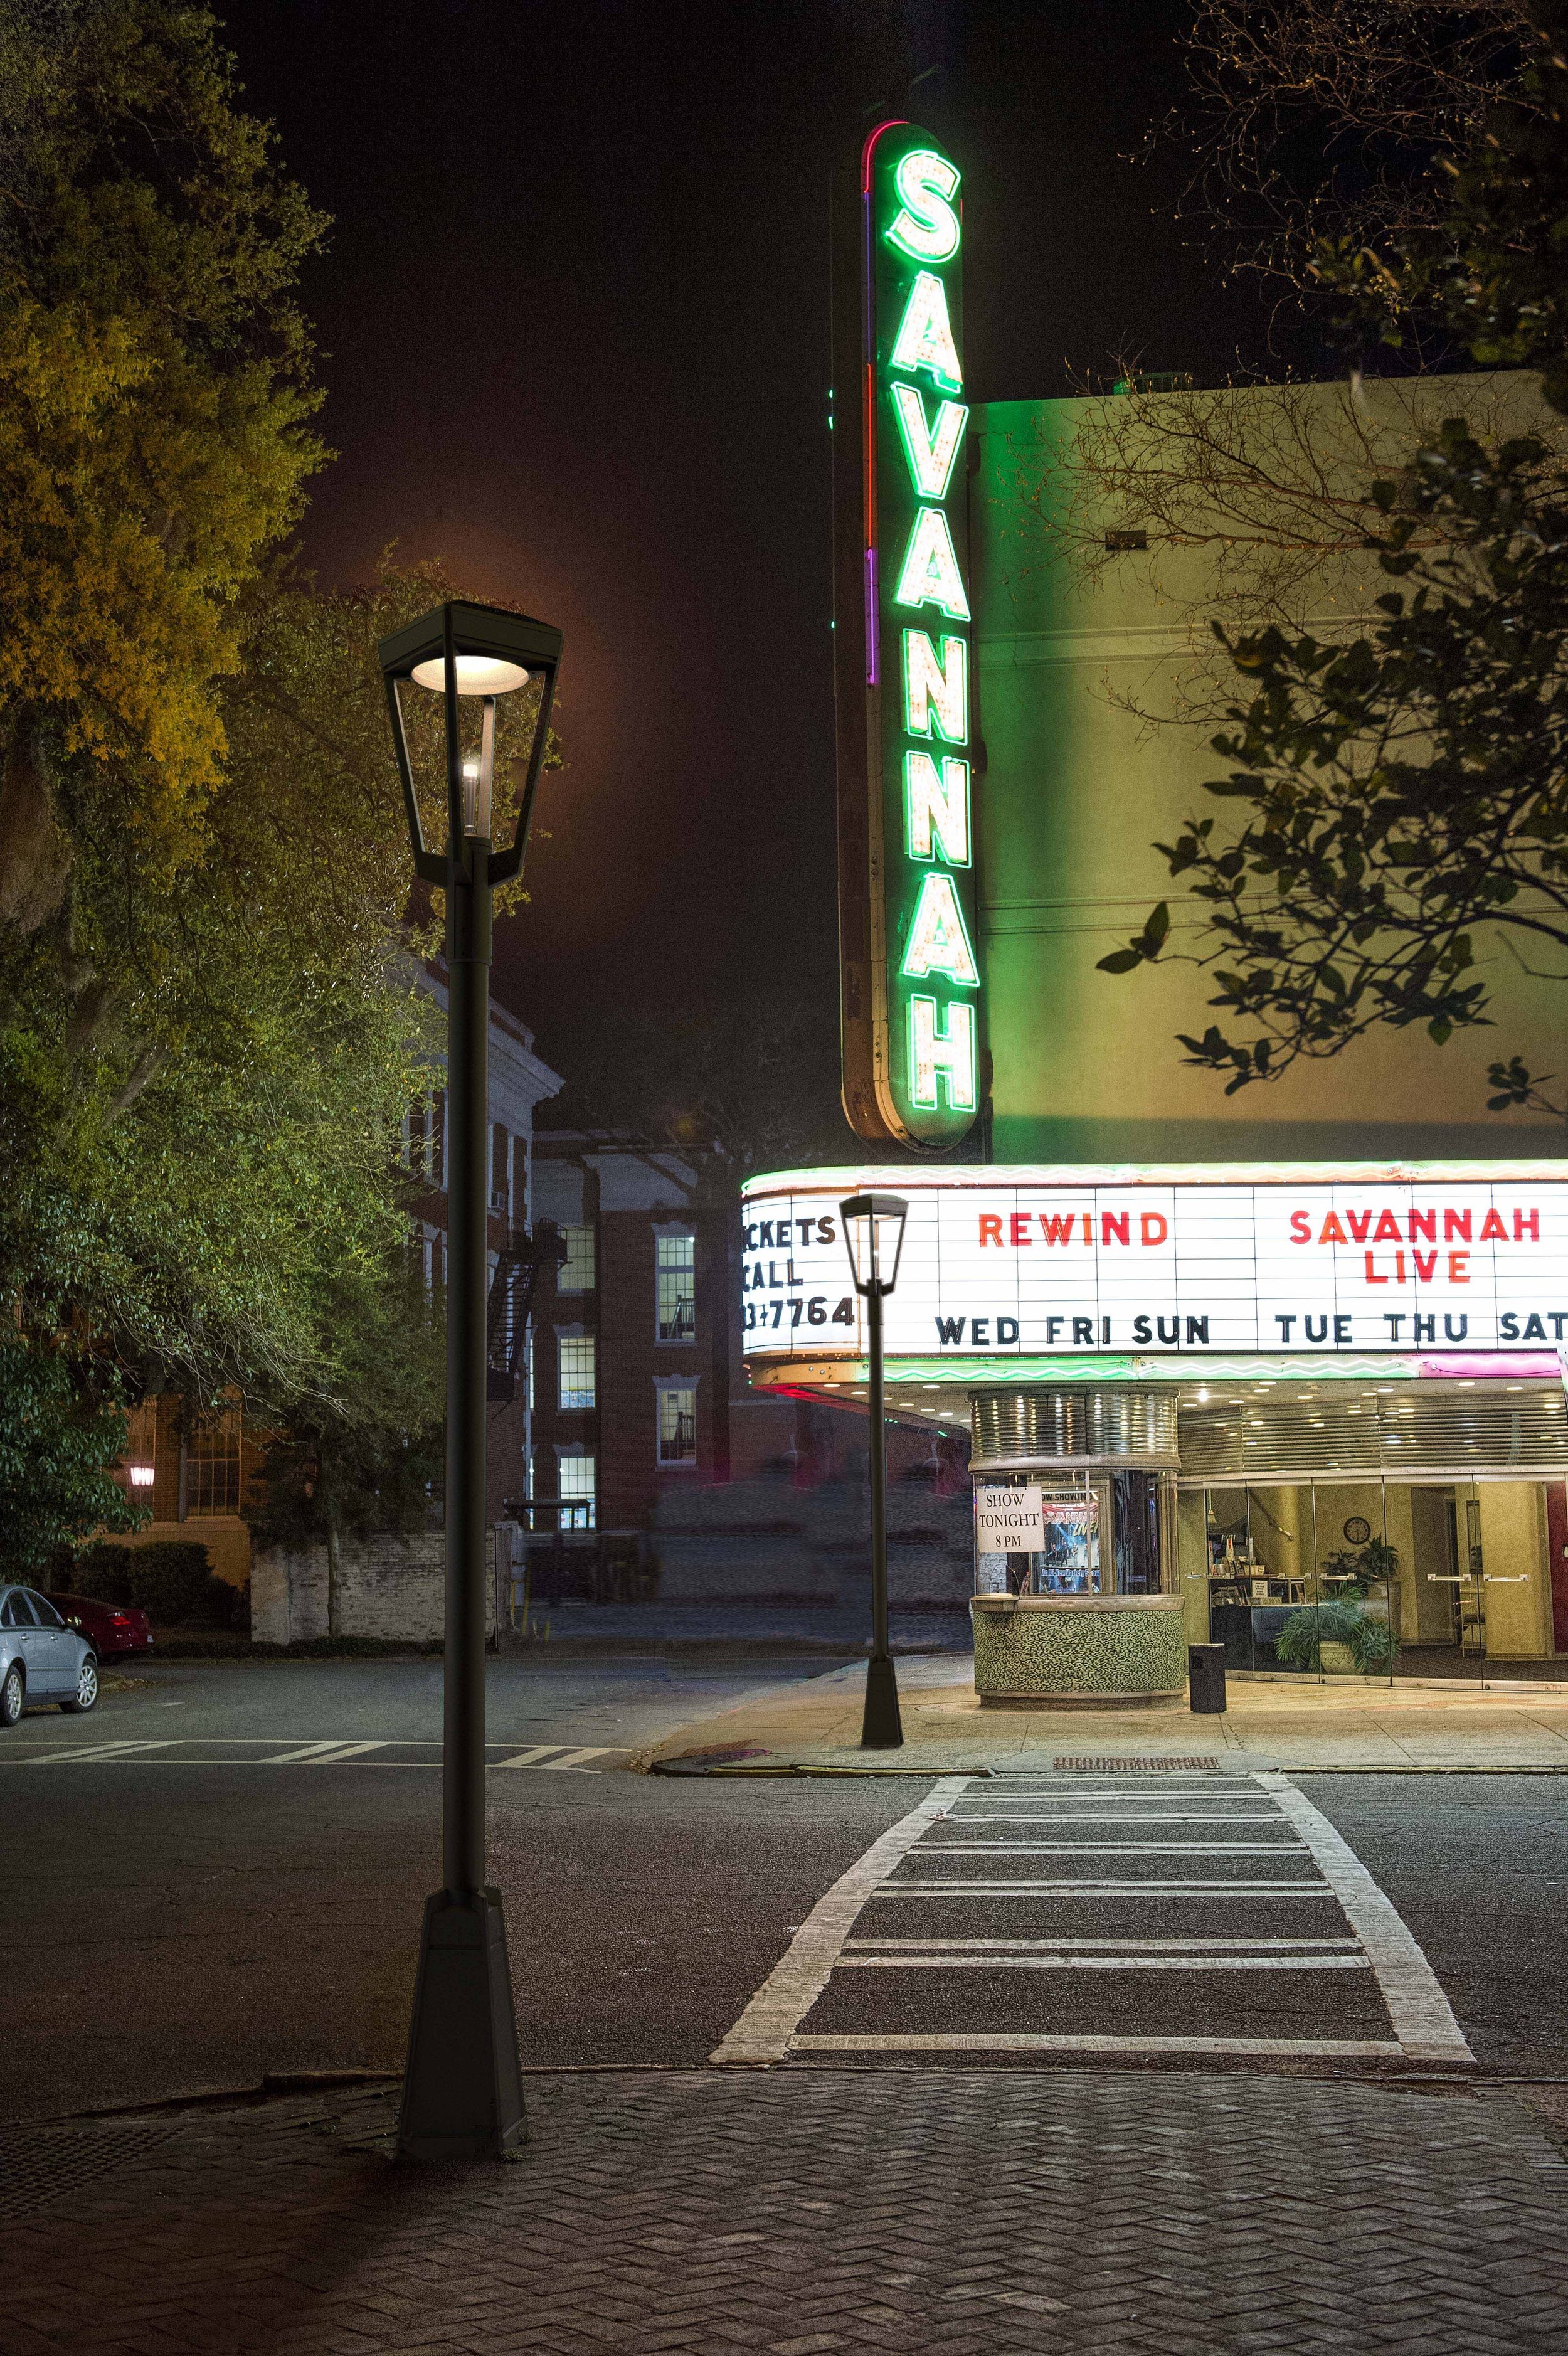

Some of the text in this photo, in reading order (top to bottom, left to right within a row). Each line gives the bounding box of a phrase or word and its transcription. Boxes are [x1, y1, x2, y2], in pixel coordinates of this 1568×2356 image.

[885, 149, 980, 1112] SAVANNAH
[742, 1216, 836, 1253] CKETS
[979, 1212, 1168, 1247] REWIND
[1290, 1208, 1540, 1244] SAVANNAH
[741, 1258, 804, 1293] CALL
[1365, 1249, 1471, 1285] LIVE
[935, 1315, 1209, 1346] WED FRI SUN
[1274, 1312, 1568, 1344] TUE THU SAT
[987, 1493, 1025, 1507] SHOW
[979, 1512, 1039, 1527] TONIGHT
[995, 1535, 1022, 1547] 8 PM
[1066, 1569, 1084, 1578] Variety
[1085, 1569, 1100, 1577] Sow
